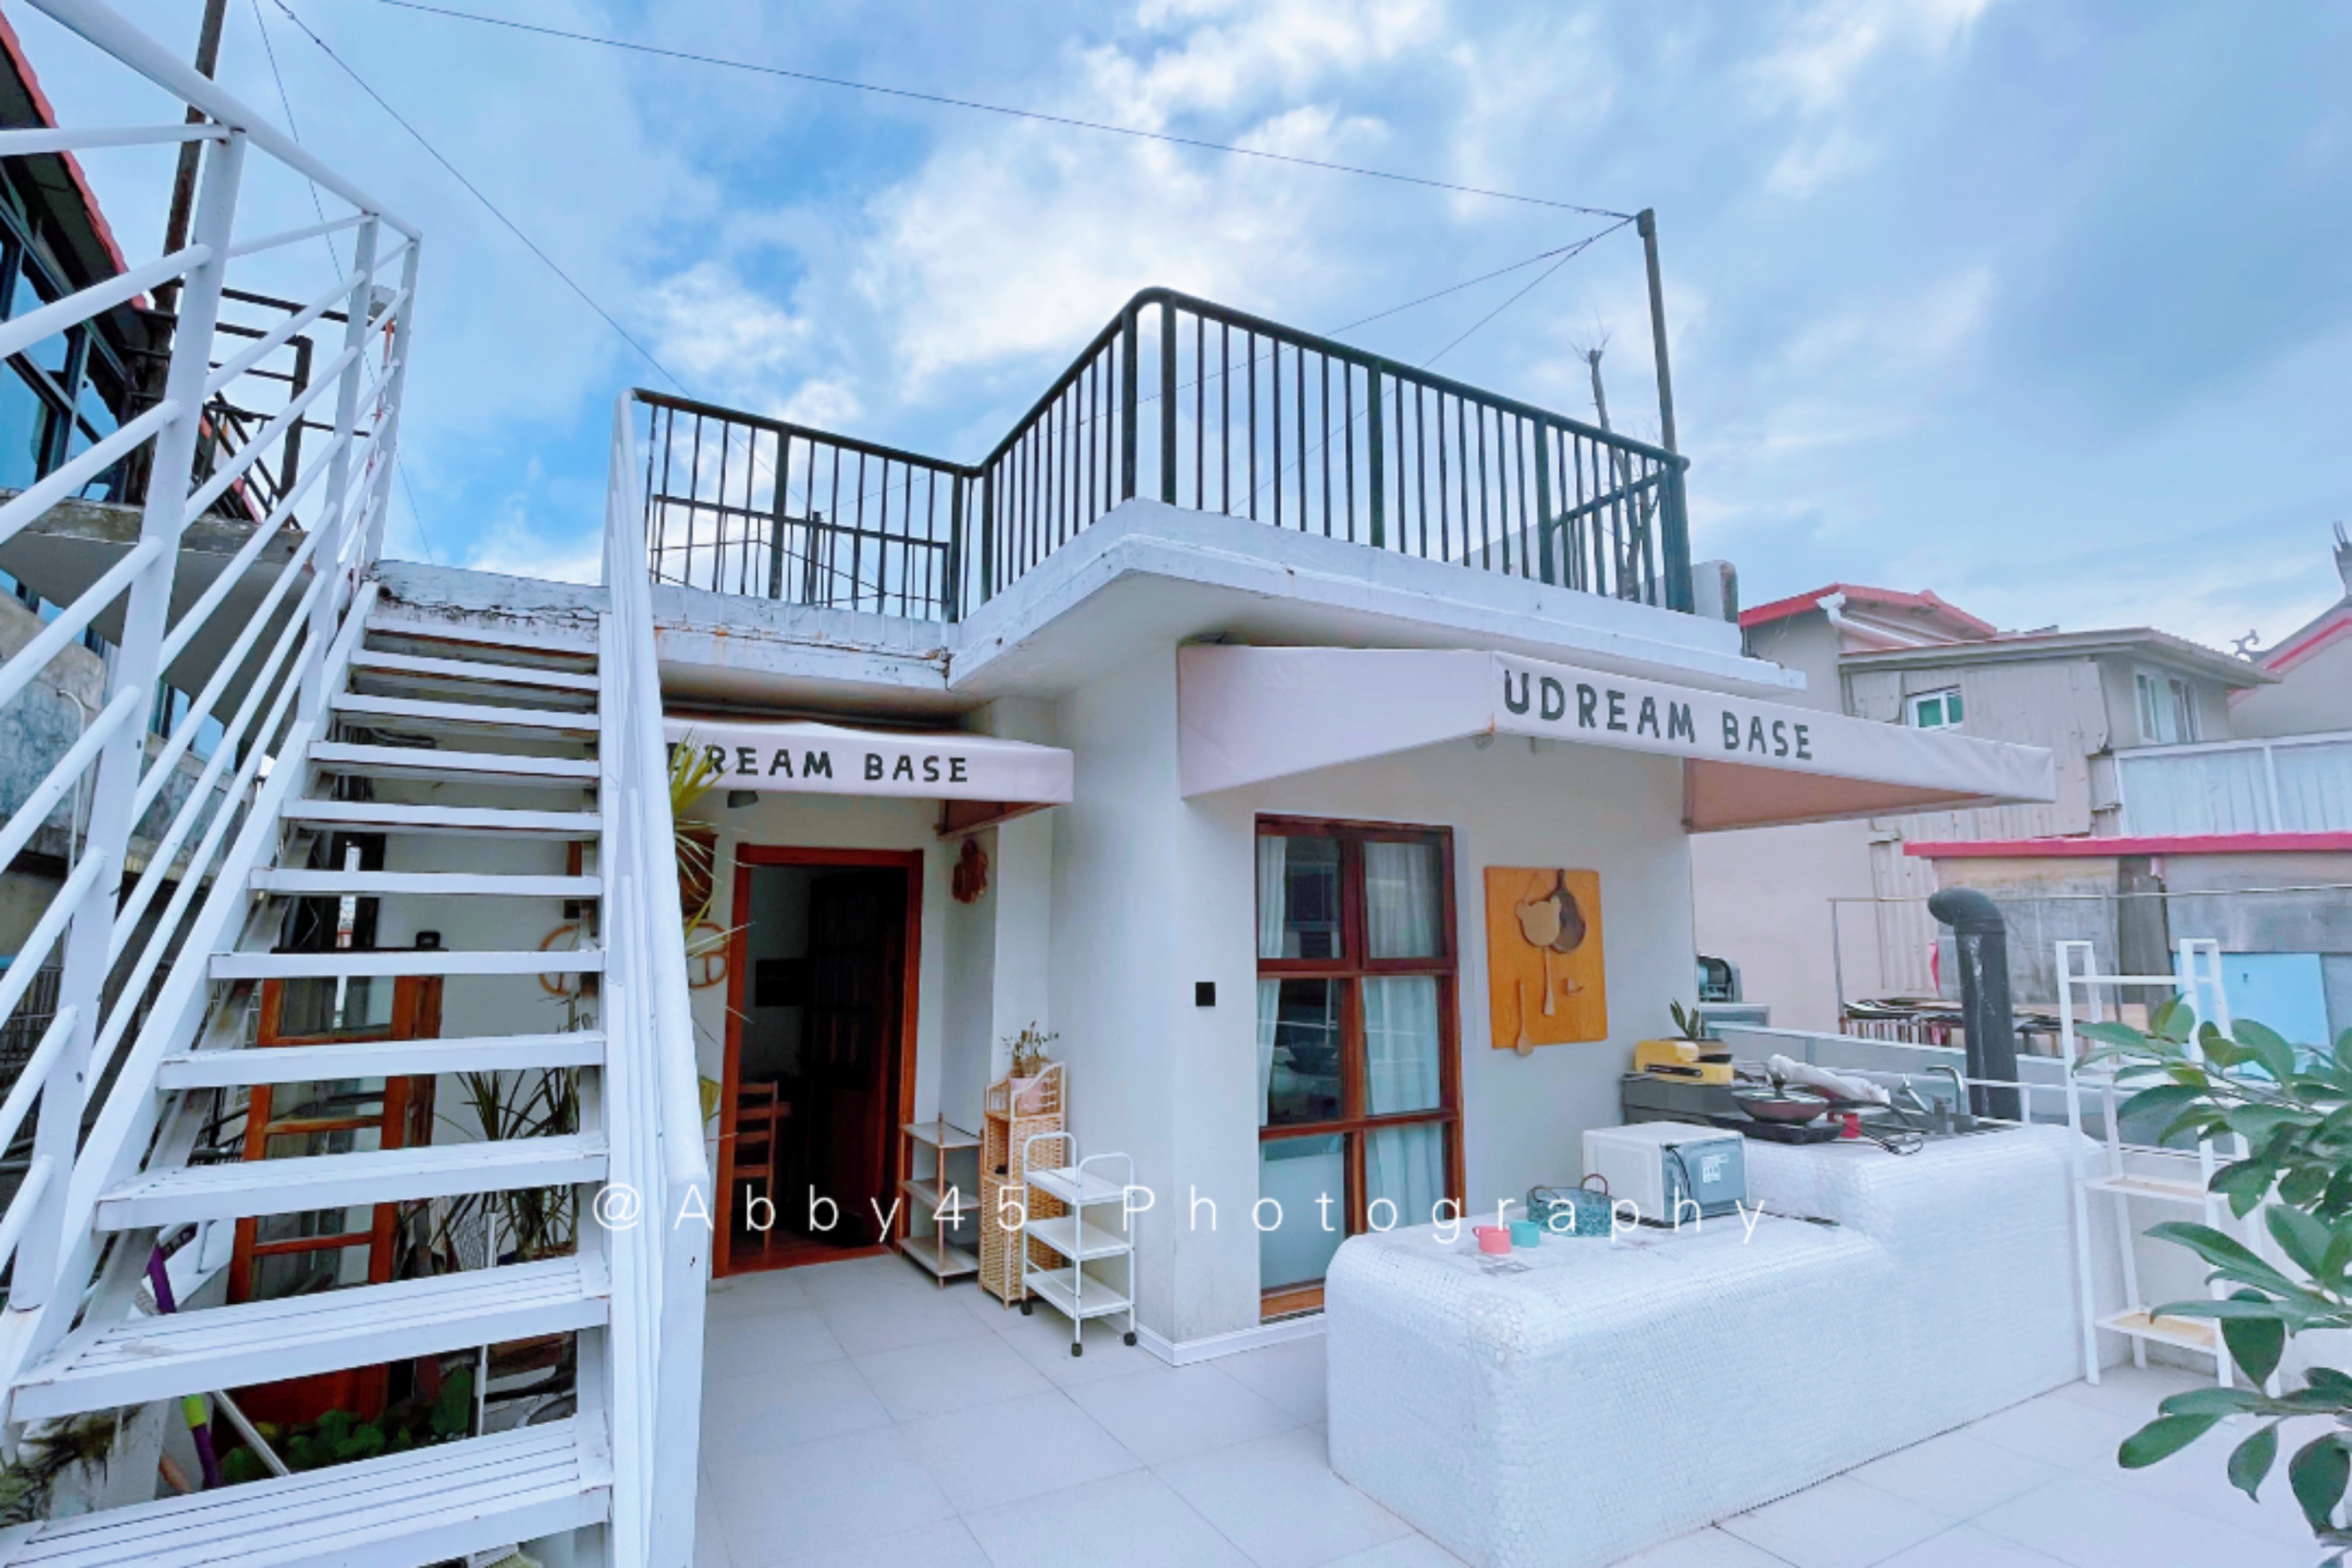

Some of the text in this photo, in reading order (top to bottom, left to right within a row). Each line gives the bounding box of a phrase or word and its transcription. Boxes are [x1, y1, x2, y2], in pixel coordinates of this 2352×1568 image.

[1504, 670, 1812, 760] UDREAM BASE
[864, 754, 968, 783] BASE
